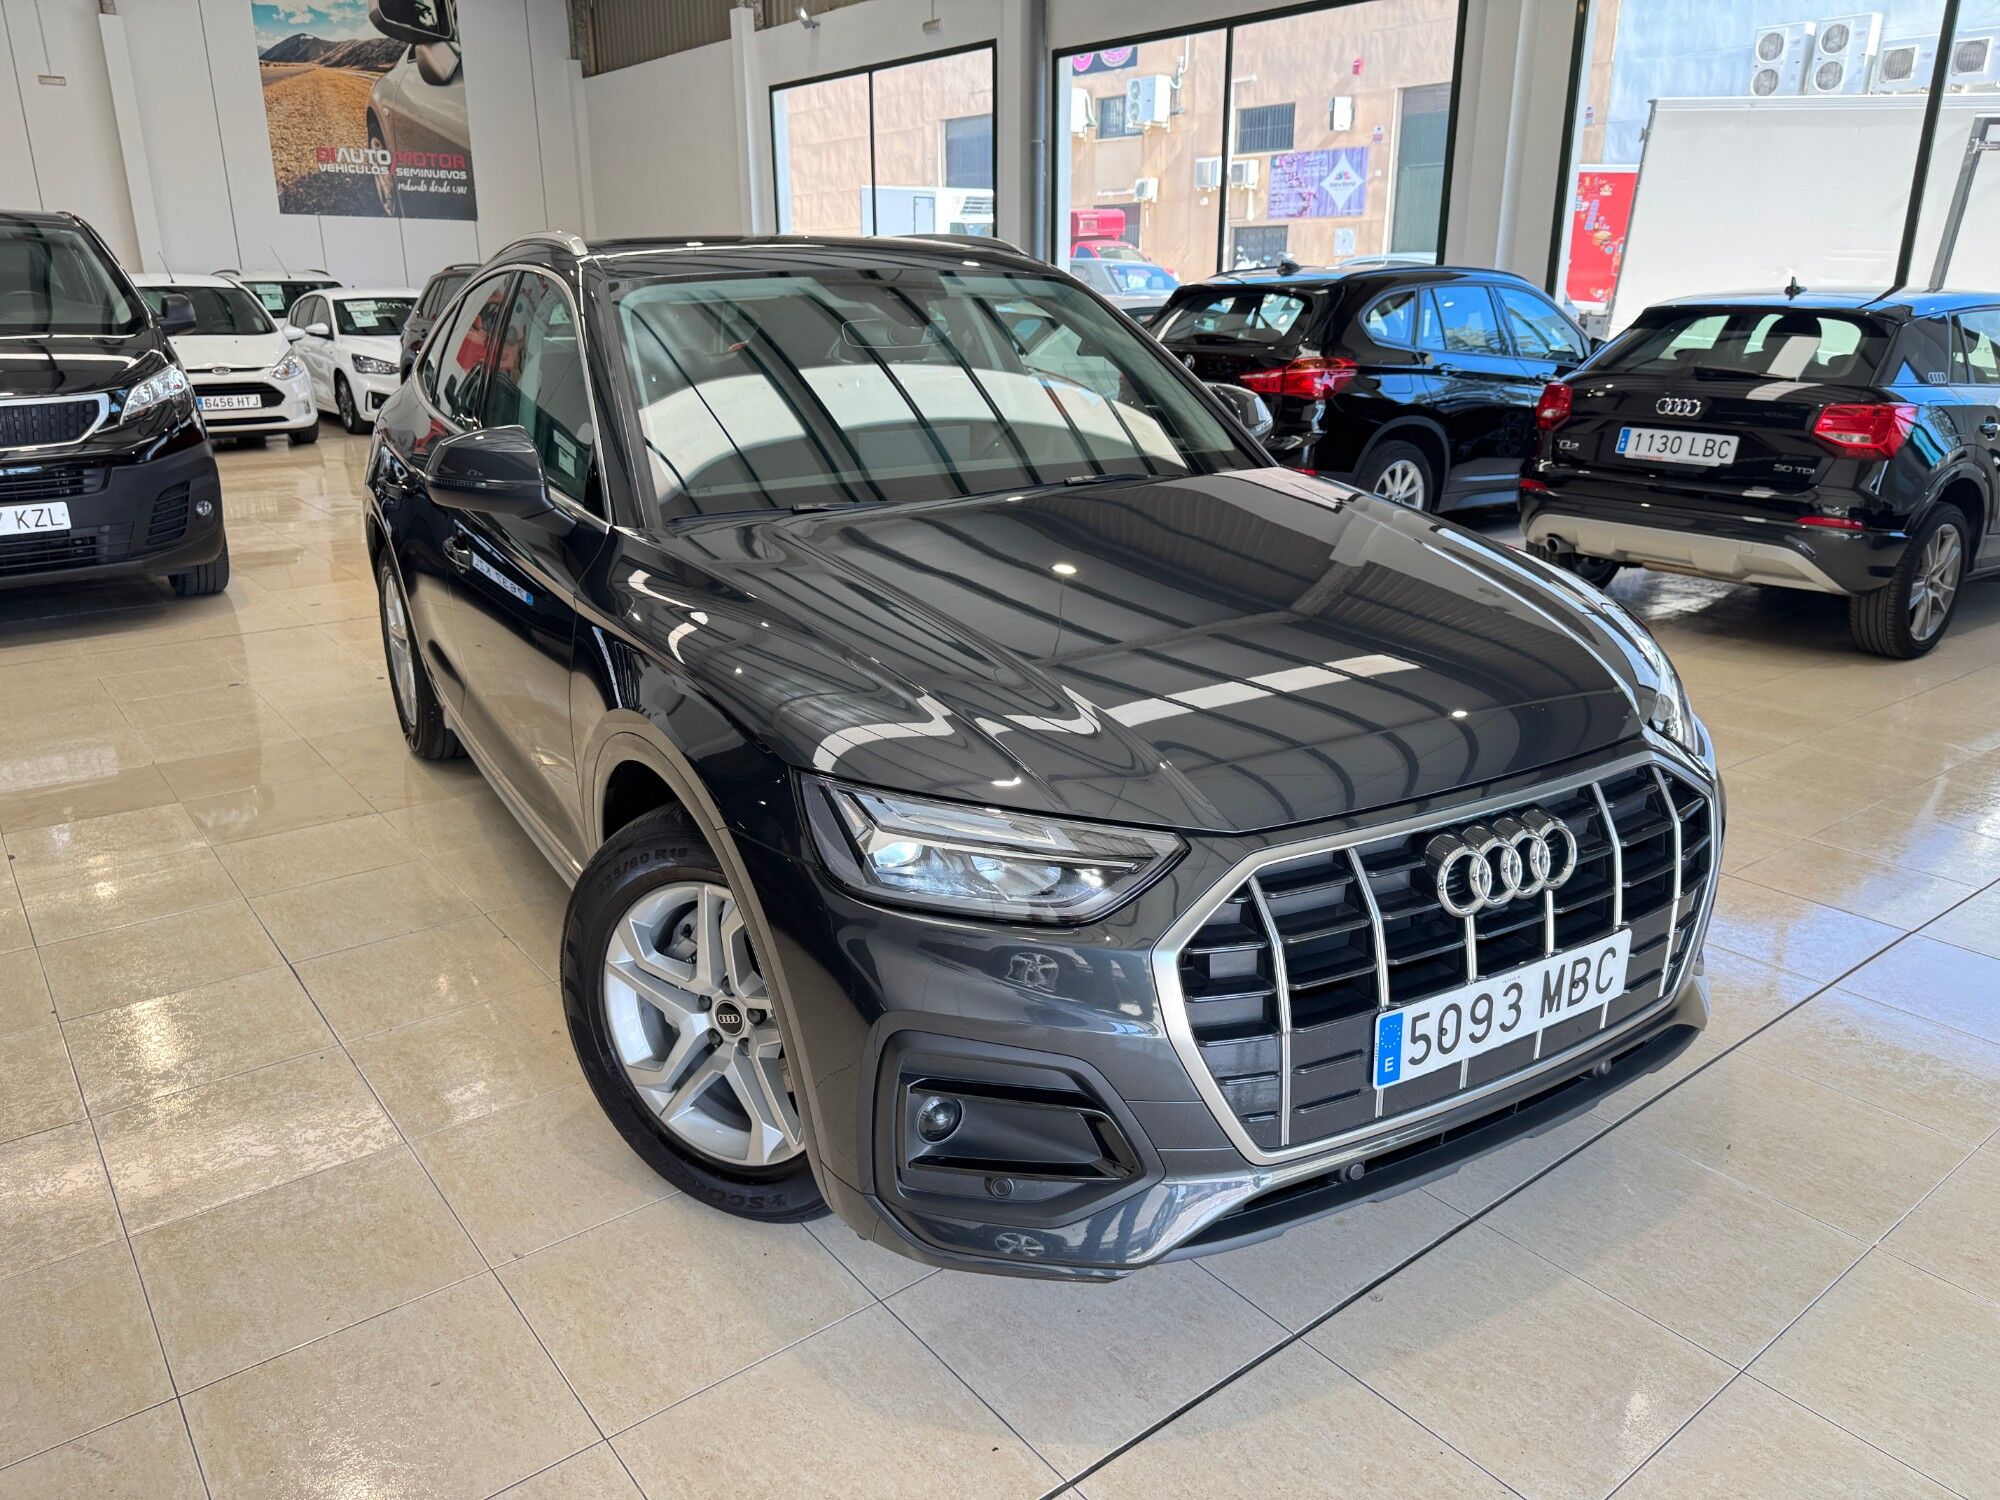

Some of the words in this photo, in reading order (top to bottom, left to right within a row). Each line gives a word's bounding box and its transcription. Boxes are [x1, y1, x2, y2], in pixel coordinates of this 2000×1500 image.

[396, 168, 467, 180] SEMINUEVOS
[429, 180, 451, 193] desde
[205, 397, 234, 408] 6456
[237, 395, 259, 407] HTJ
[1635, 433, 1682, 454] 1130
[1688, 437, 1731, 459] LBC
[1795, 466, 1815, 474] TDI
[15, 508, 64, 529] KZL
[1407, 982, 1523, 1066] 5093
[1539, 946, 1617, 1019] MBC
[1384, 1056, 1394, 1072] E
